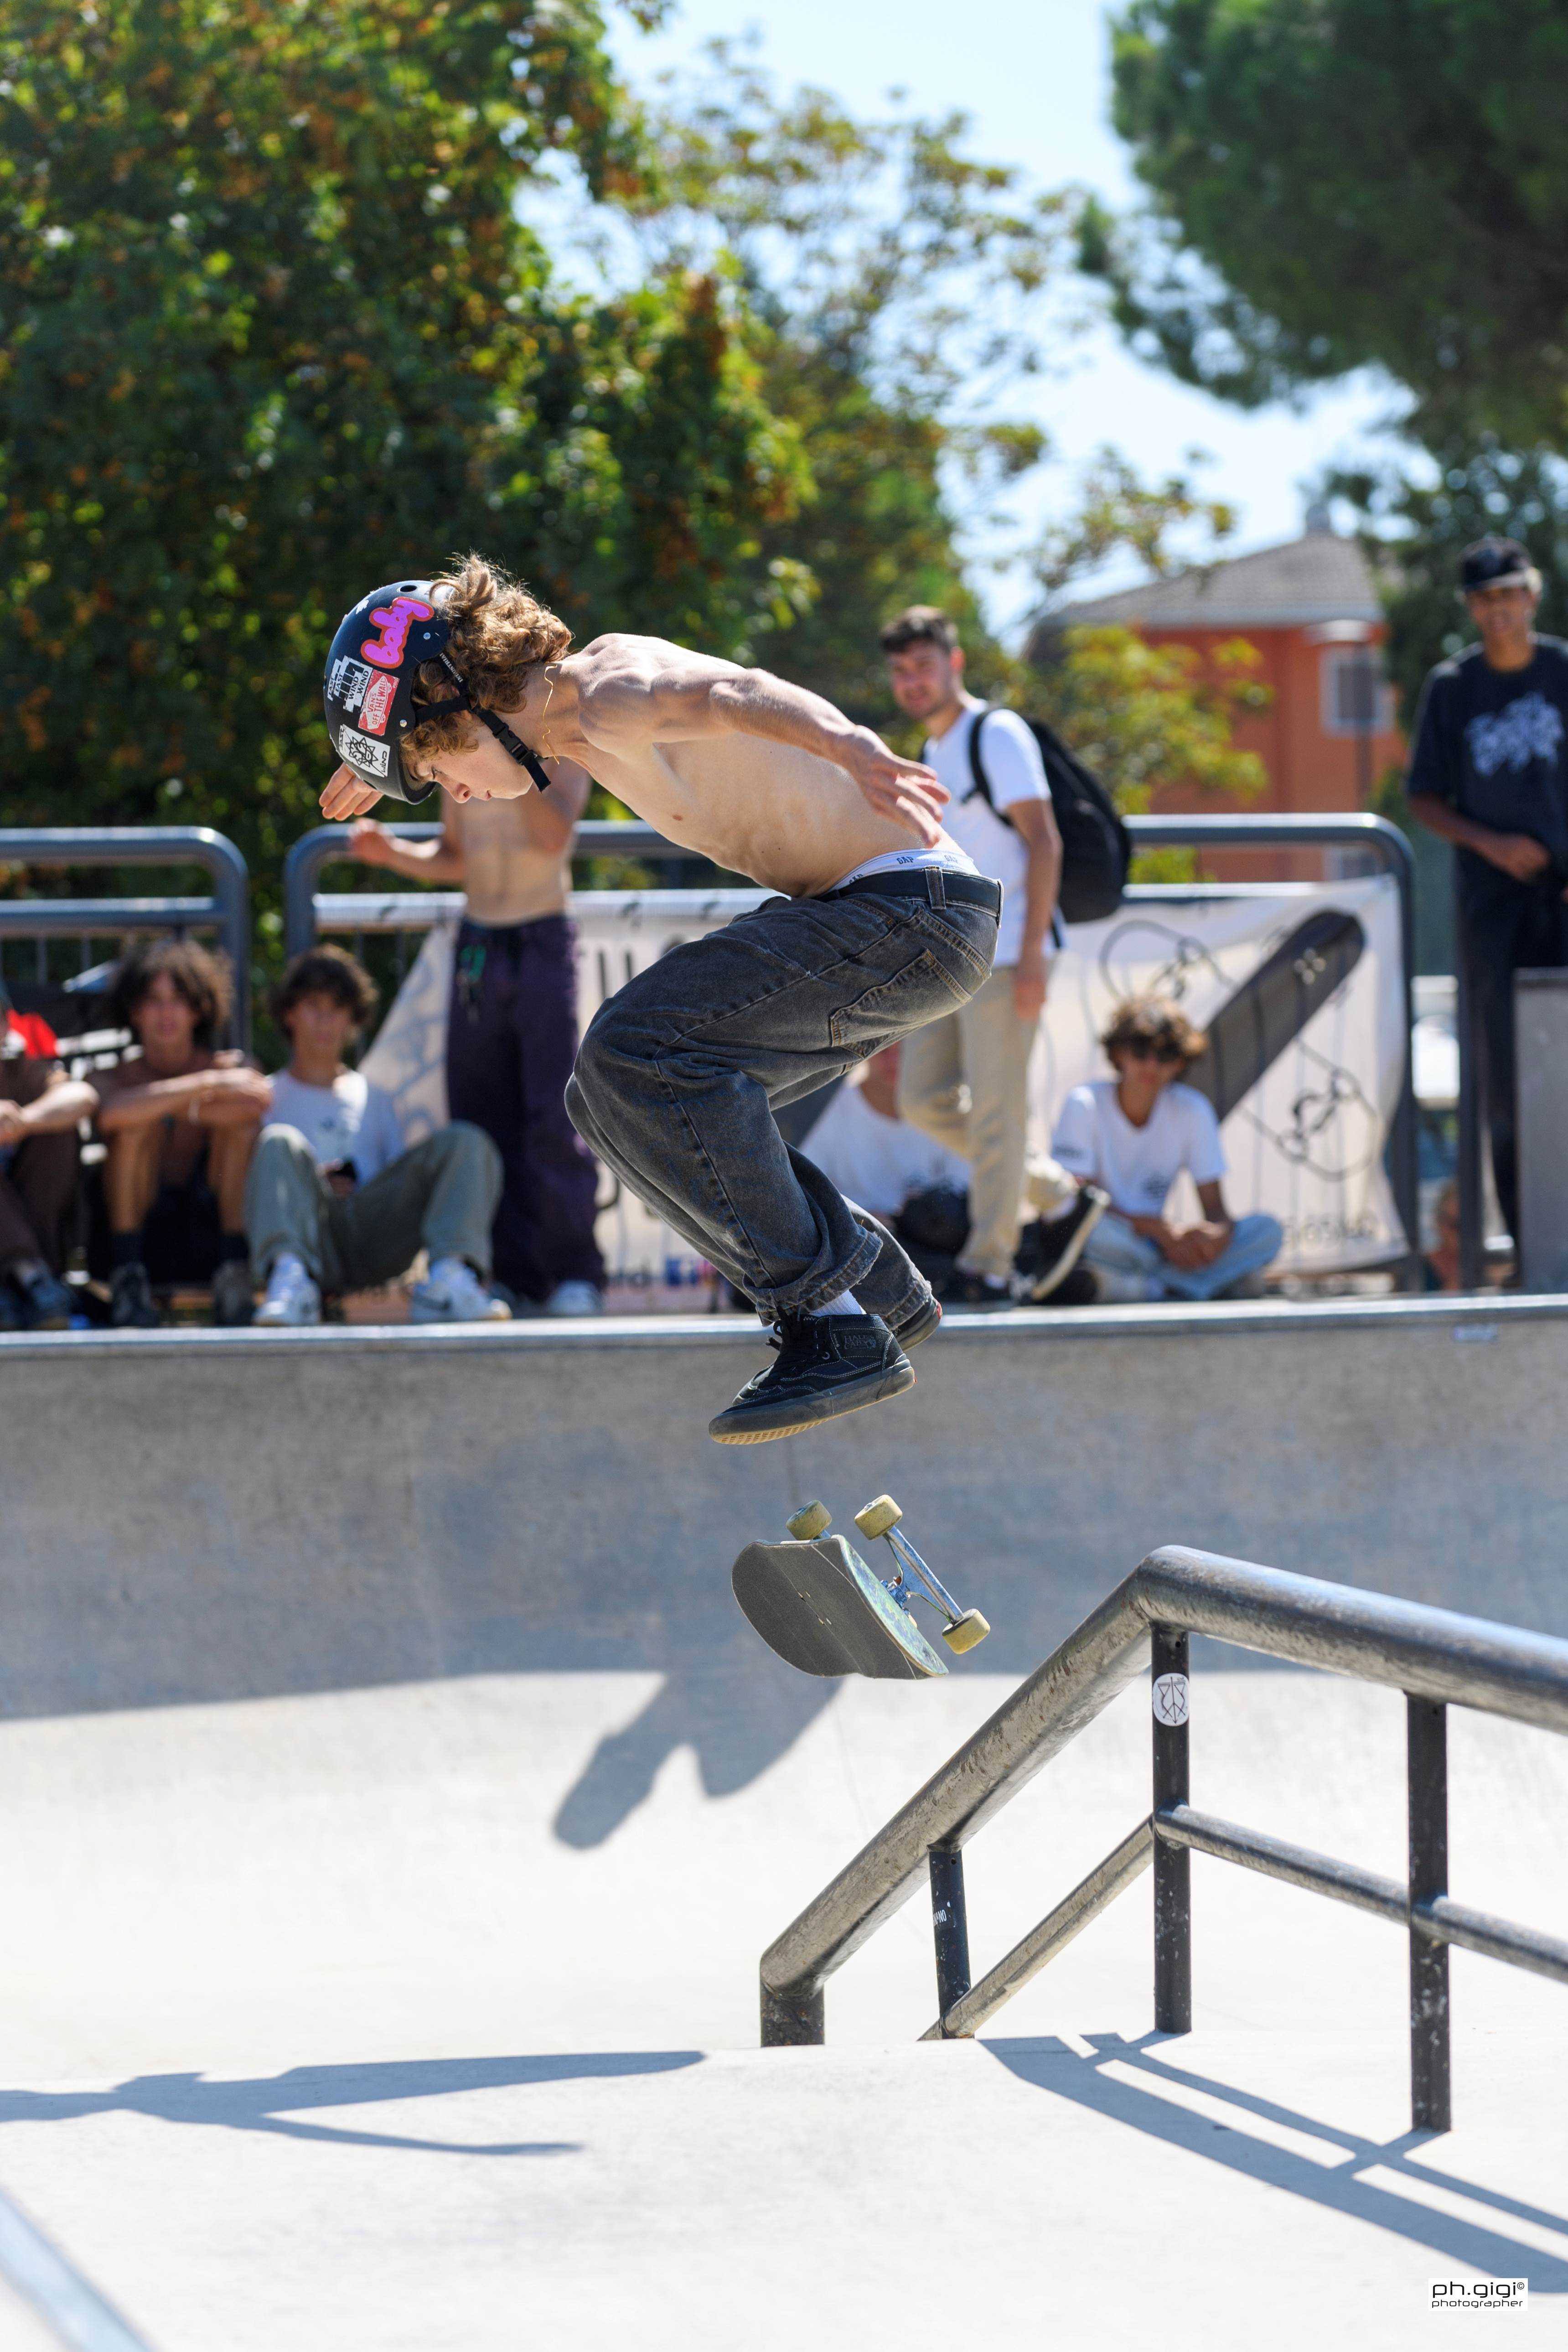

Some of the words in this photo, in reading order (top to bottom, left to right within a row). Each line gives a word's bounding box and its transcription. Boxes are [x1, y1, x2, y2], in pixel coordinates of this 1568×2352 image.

[349, 676, 359, 699] WIND
[357, 670, 369, 694] WIND
[367, 693, 377, 713] VANS
[375, 697, 385, 712] THE
[372, 711, 380, 725] OFF
[896, 855, 914, 865] GAP
[944, 855, 958, 863] GAP
